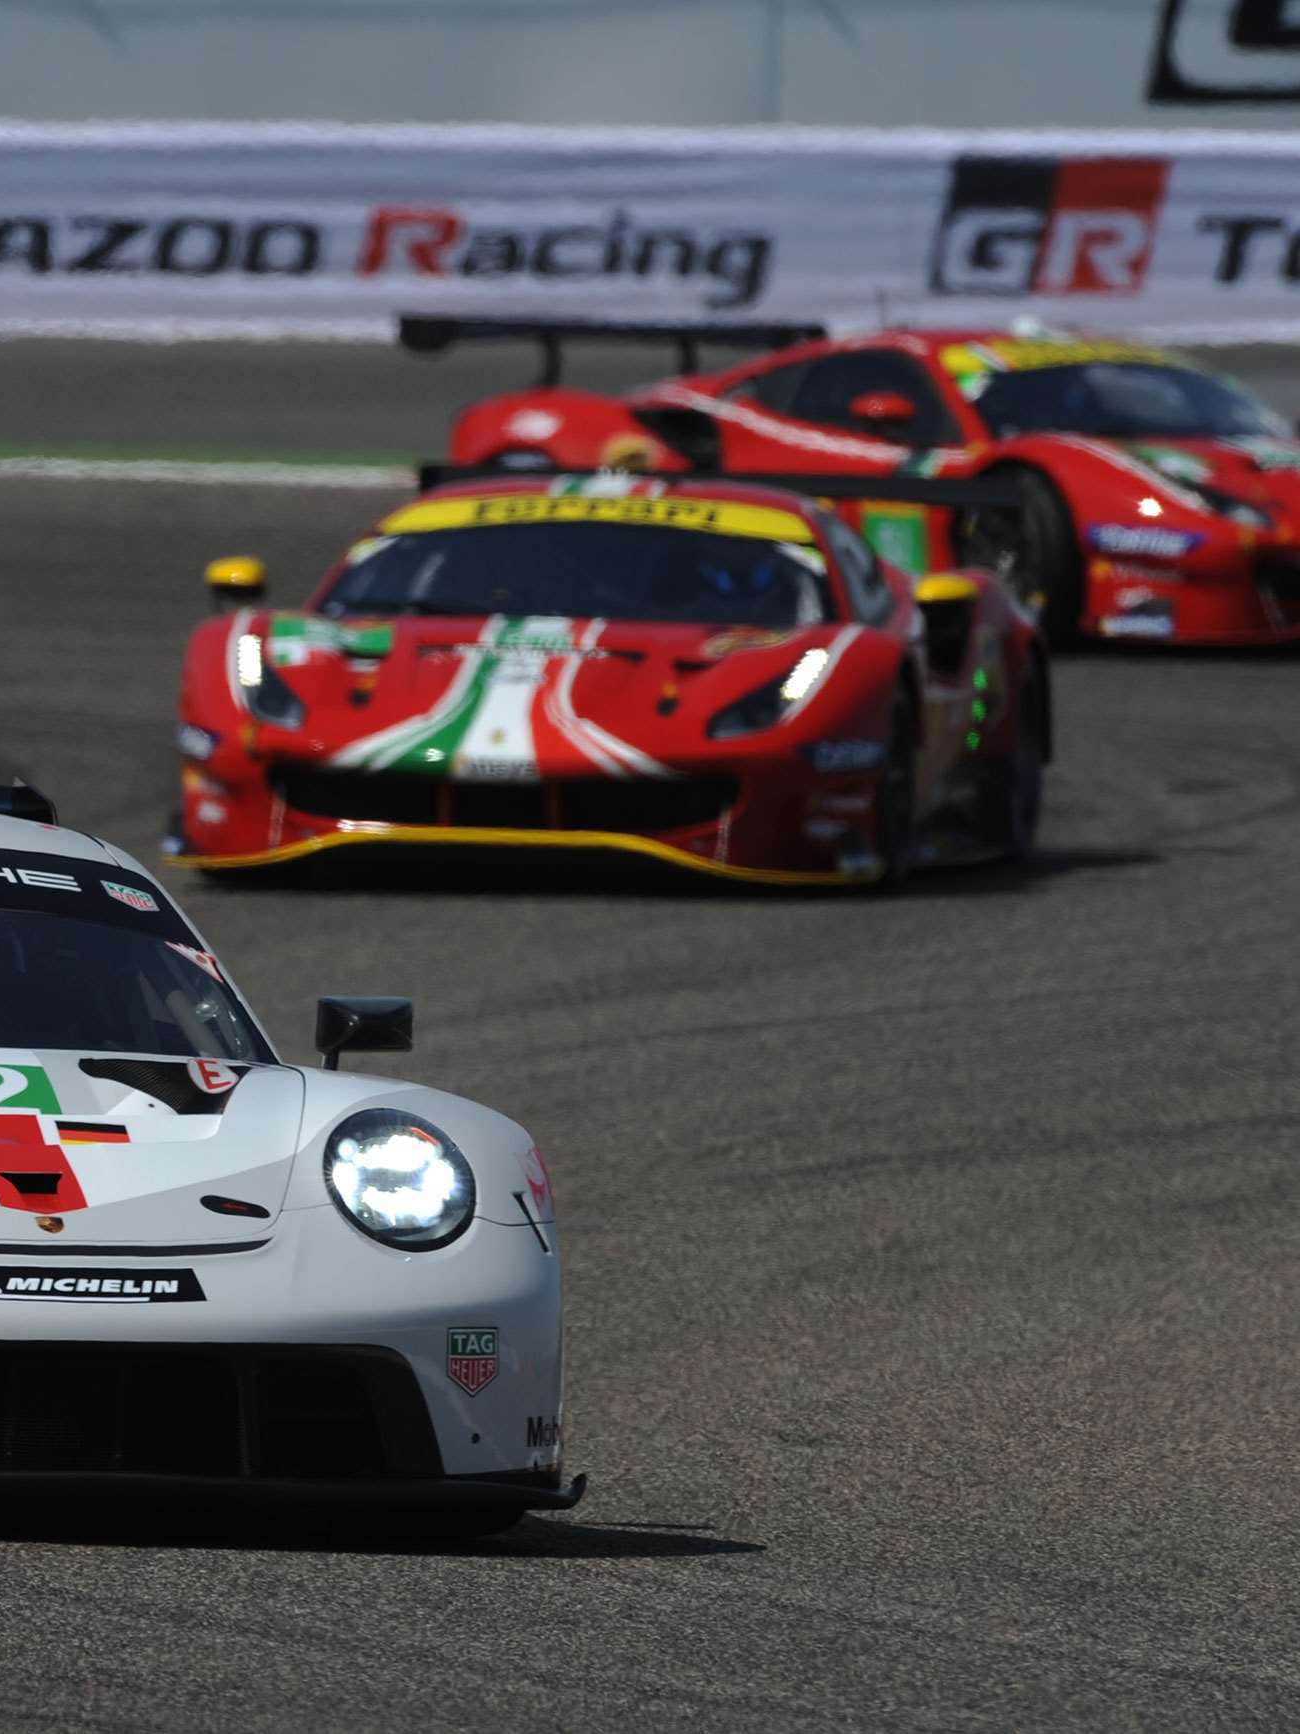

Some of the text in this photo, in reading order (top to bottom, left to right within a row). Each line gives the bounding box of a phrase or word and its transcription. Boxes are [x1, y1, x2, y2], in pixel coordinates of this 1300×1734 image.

[357, 205, 773, 308] Racing
[1196, 213, 1300, 285] T
[196, 1058, 233, 1092] E
[6, 1276, 181, 1295] MICHELIN
[453, 1334, 494, 1354] TAG
[451, 1359, 496, 1390] HEUER
